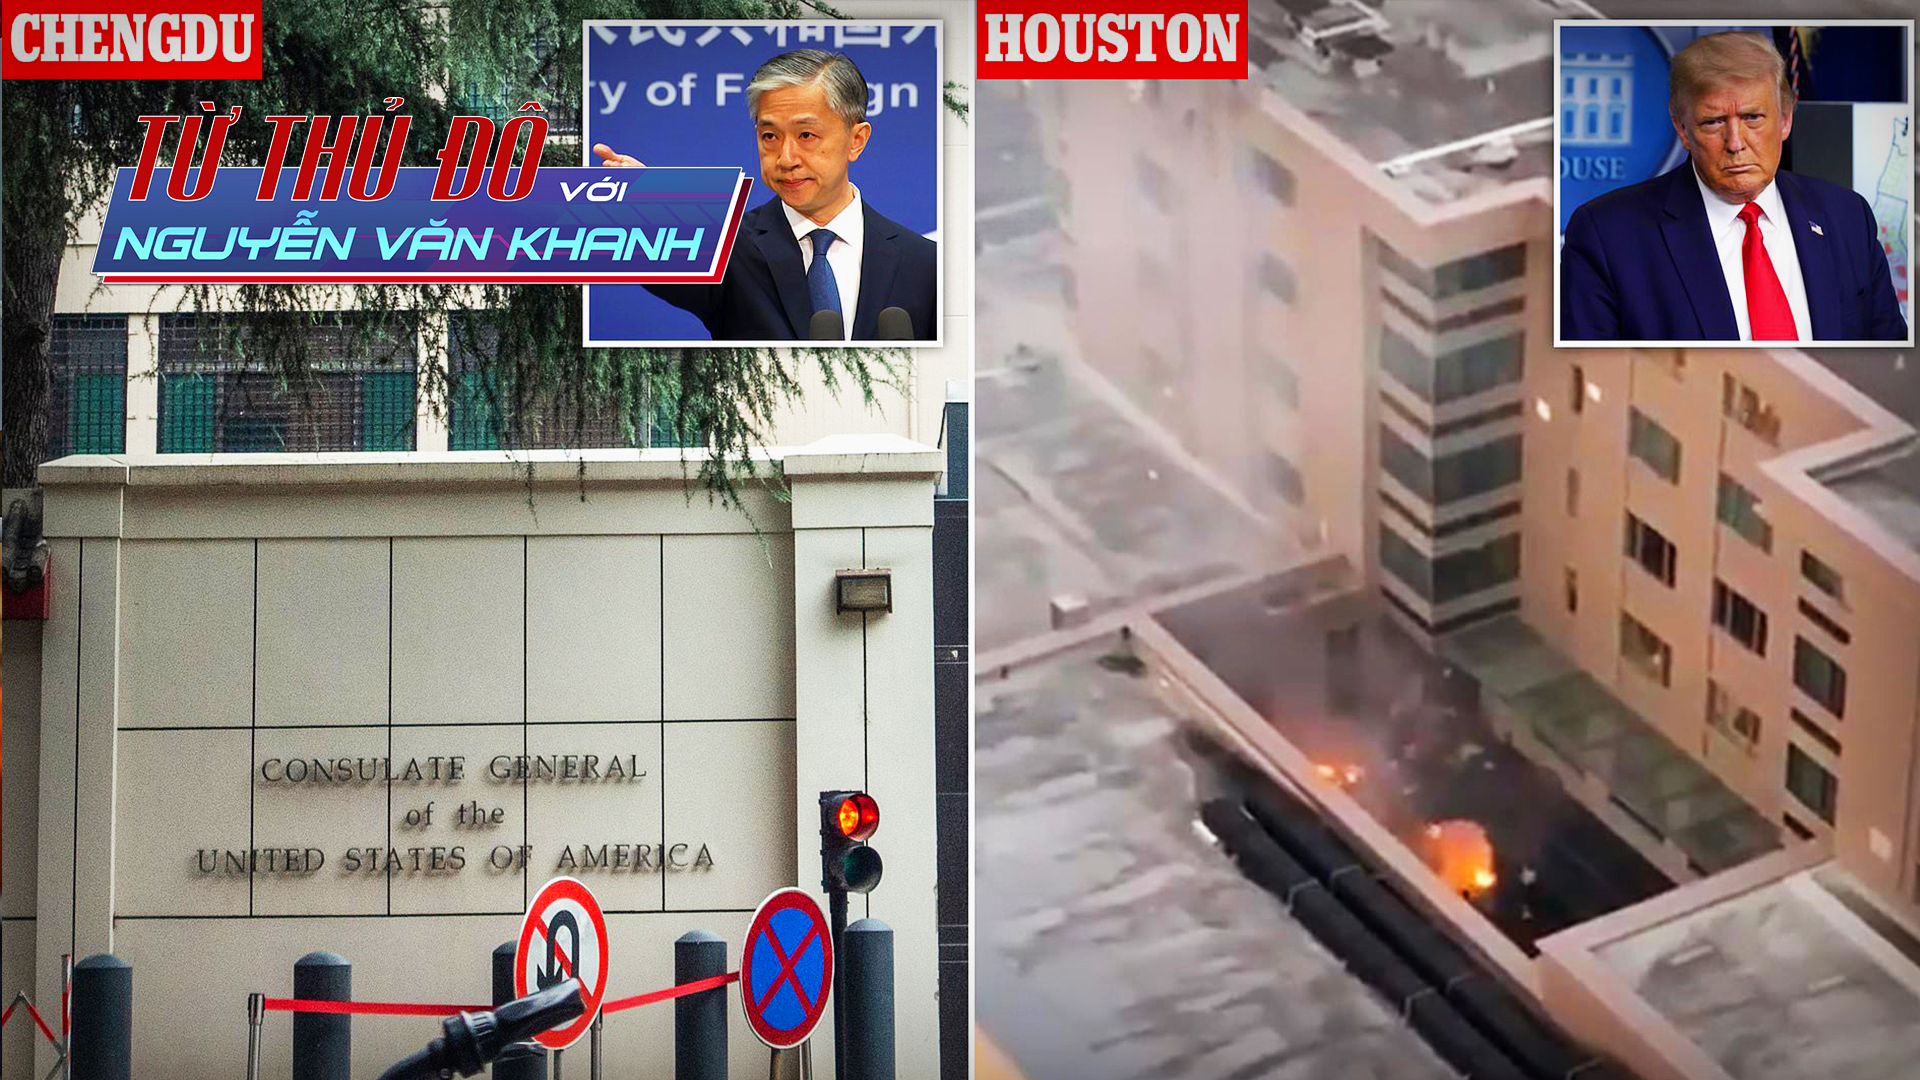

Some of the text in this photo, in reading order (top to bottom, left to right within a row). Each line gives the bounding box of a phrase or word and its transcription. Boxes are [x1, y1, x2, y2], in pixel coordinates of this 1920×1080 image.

[646, 72, 697, 106] of
[261, 754, 647, 783] CONSULATE GENERAL
[405, 801, 505, 826] of the
[196, 842, 715, 874] UNITED STATES OF AMERICA
